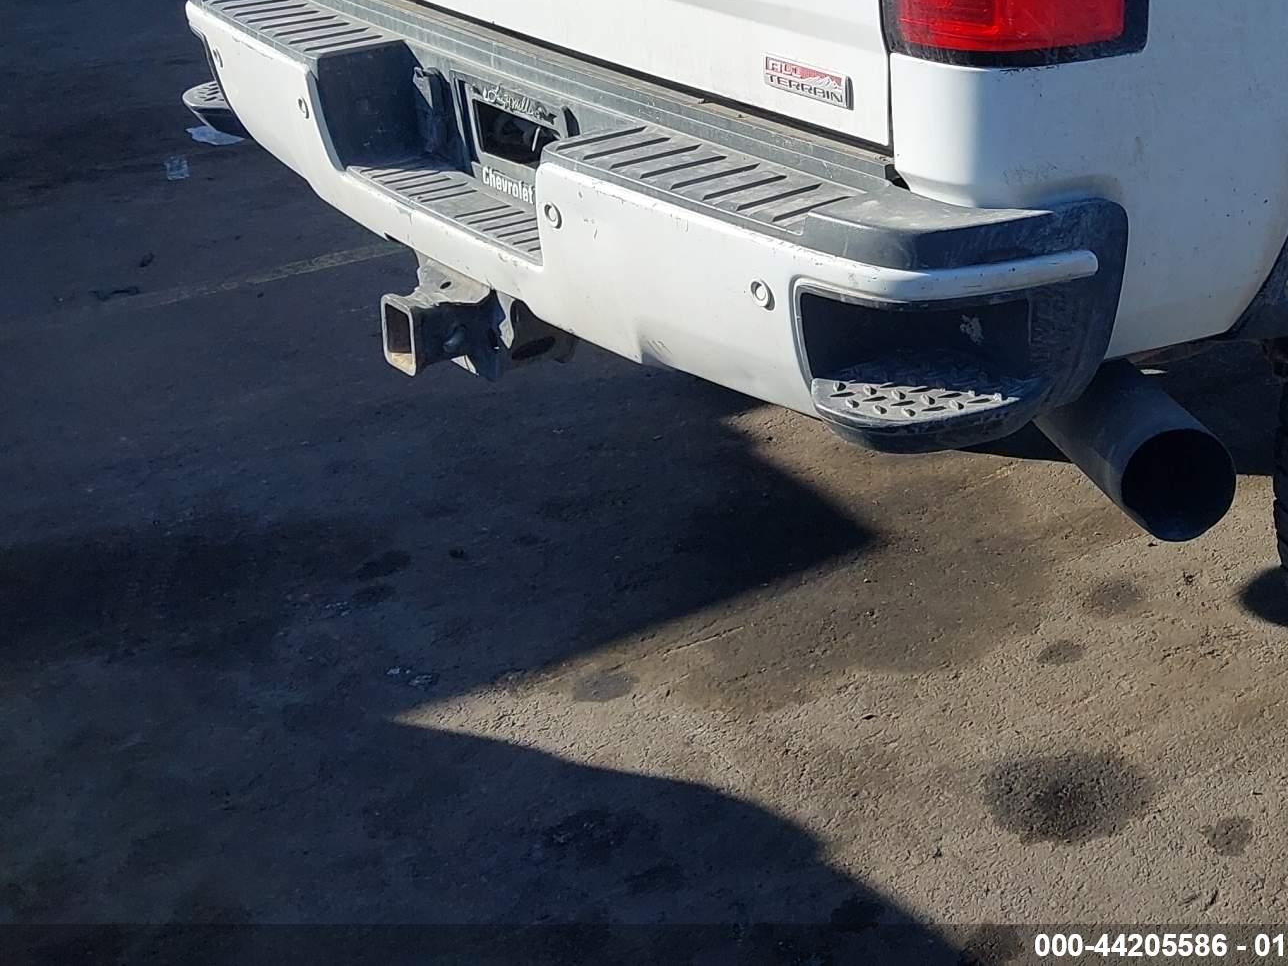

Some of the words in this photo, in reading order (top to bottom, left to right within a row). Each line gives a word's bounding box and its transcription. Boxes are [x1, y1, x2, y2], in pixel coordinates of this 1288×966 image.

[767, 58, 802, 78] ALL
[767, 74, 844, 103] TERRAIN
[482, 166, 536, 204] Chevrolet
